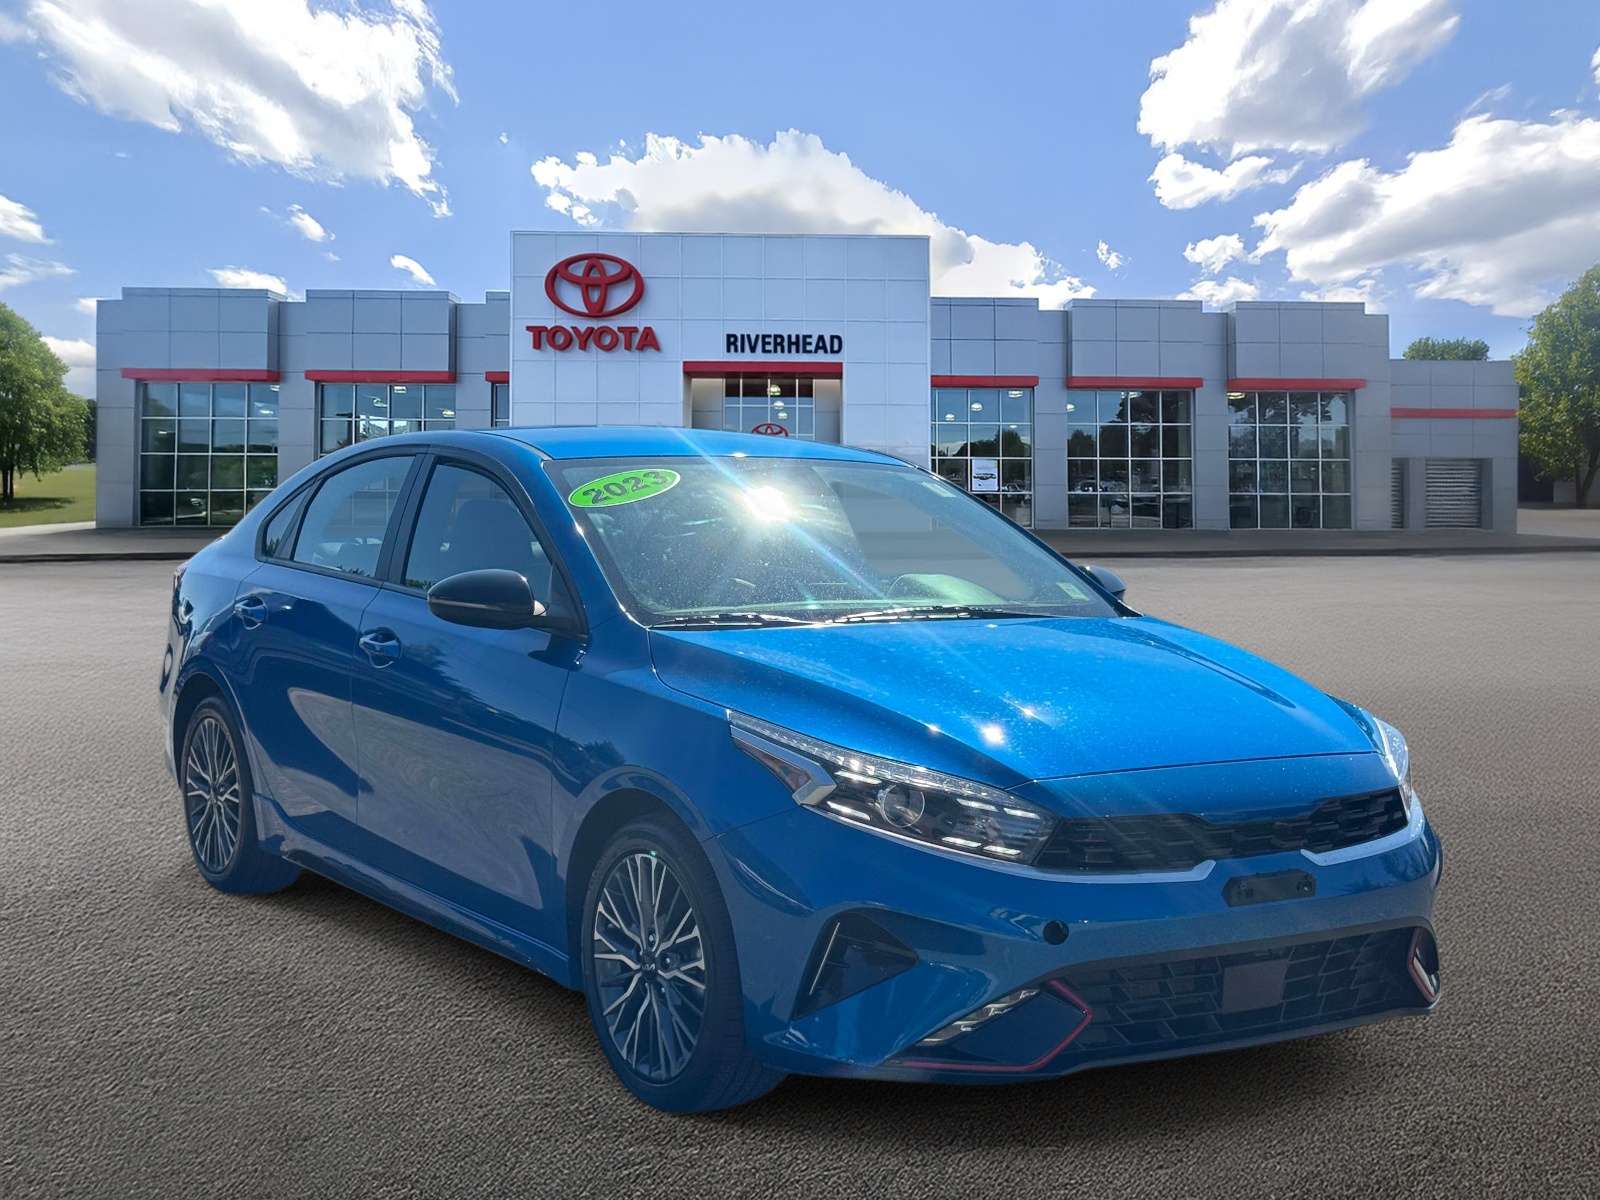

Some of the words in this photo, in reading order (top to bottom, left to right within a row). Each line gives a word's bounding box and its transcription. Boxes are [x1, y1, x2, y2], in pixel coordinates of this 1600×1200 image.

[525, 325, 661, 352] TOYOTA
[726, 333, 843, 354] RIVERHEAD
[582, 471, 668, 505] 2023
